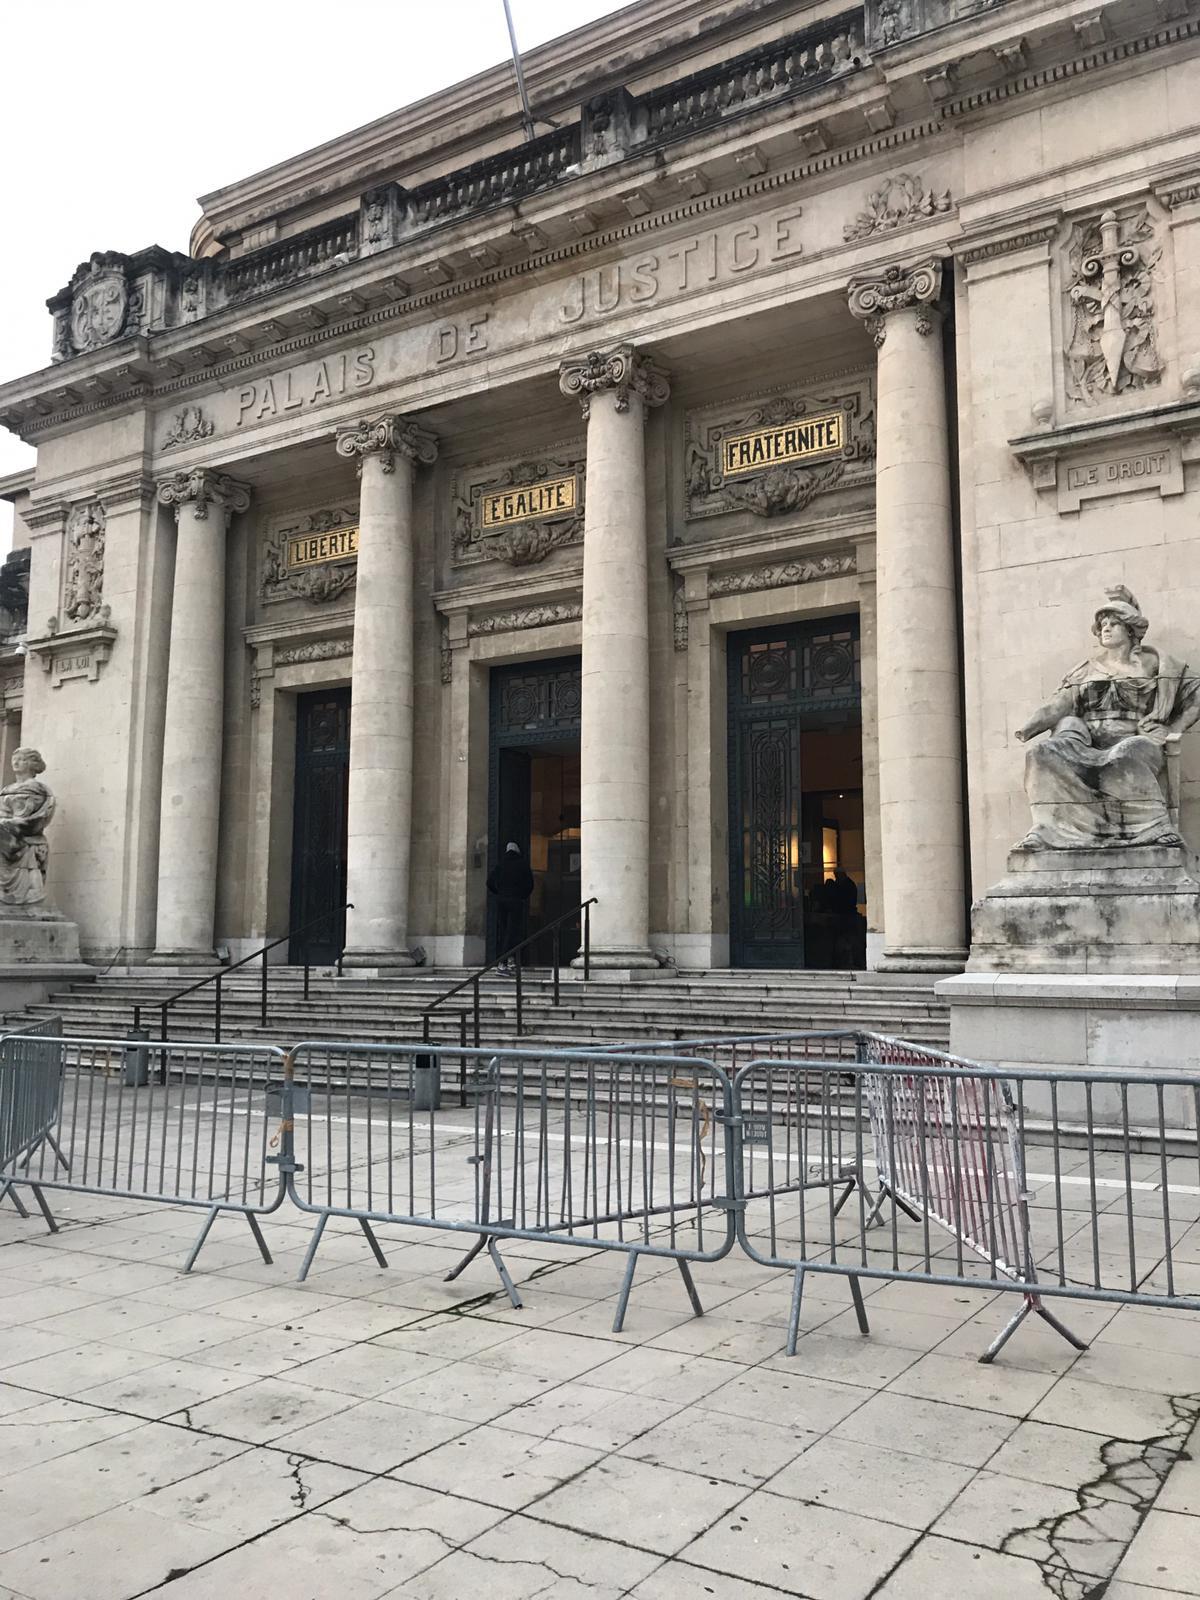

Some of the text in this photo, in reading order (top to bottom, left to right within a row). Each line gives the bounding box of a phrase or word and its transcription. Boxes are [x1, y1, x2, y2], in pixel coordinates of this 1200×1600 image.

[236, 206, 803, 426] PALAIS DE JUSTICE
[1073, 454, 1165, 488] LE DROIT
